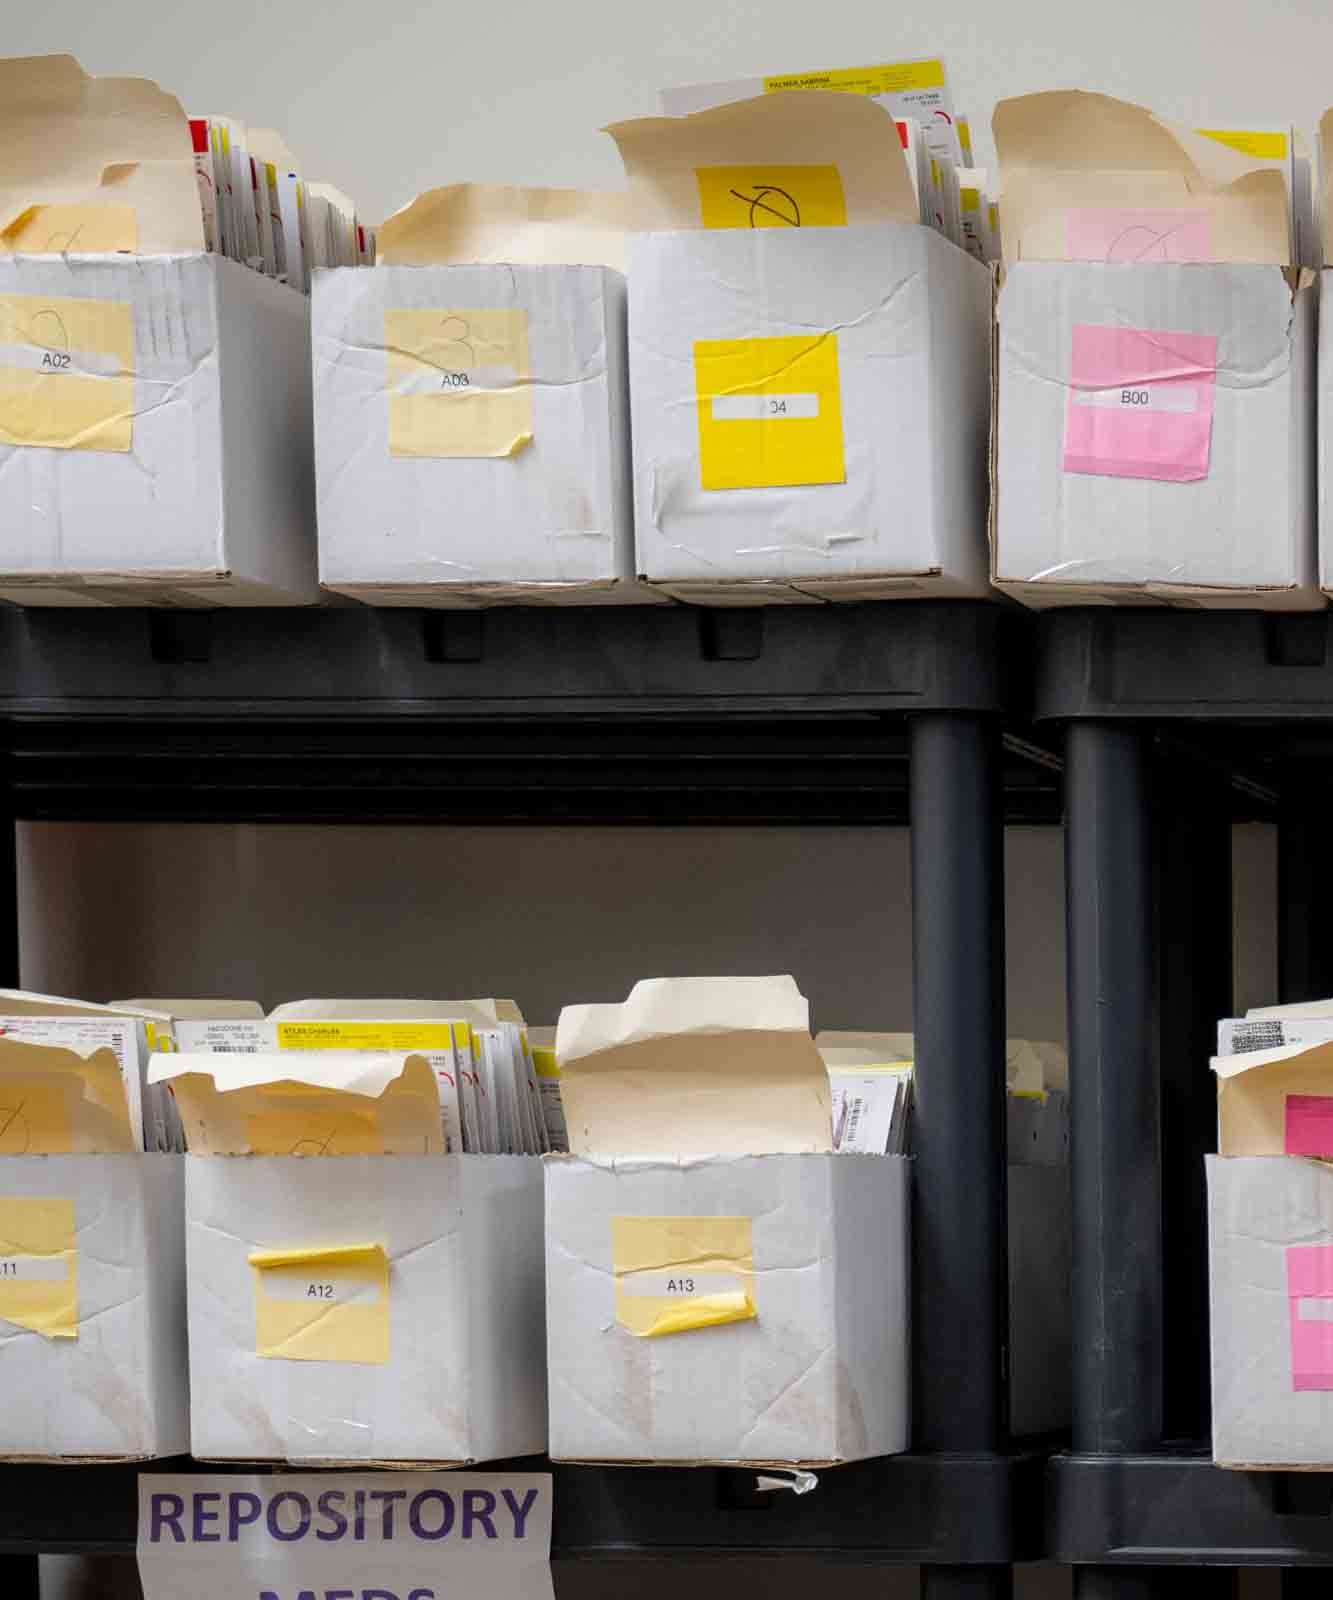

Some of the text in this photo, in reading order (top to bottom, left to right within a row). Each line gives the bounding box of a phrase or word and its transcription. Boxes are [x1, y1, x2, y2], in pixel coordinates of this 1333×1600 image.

[42, 353, 71, 368] A02
[1121, 391, 1149, 405] B00
[0, 1262, 17, 1275] 11
[307, 1284, 334, 1298] A12
[667, 1279, 695, 1292] A13
[149, 1488, 539, 1543] REPOSITORY
